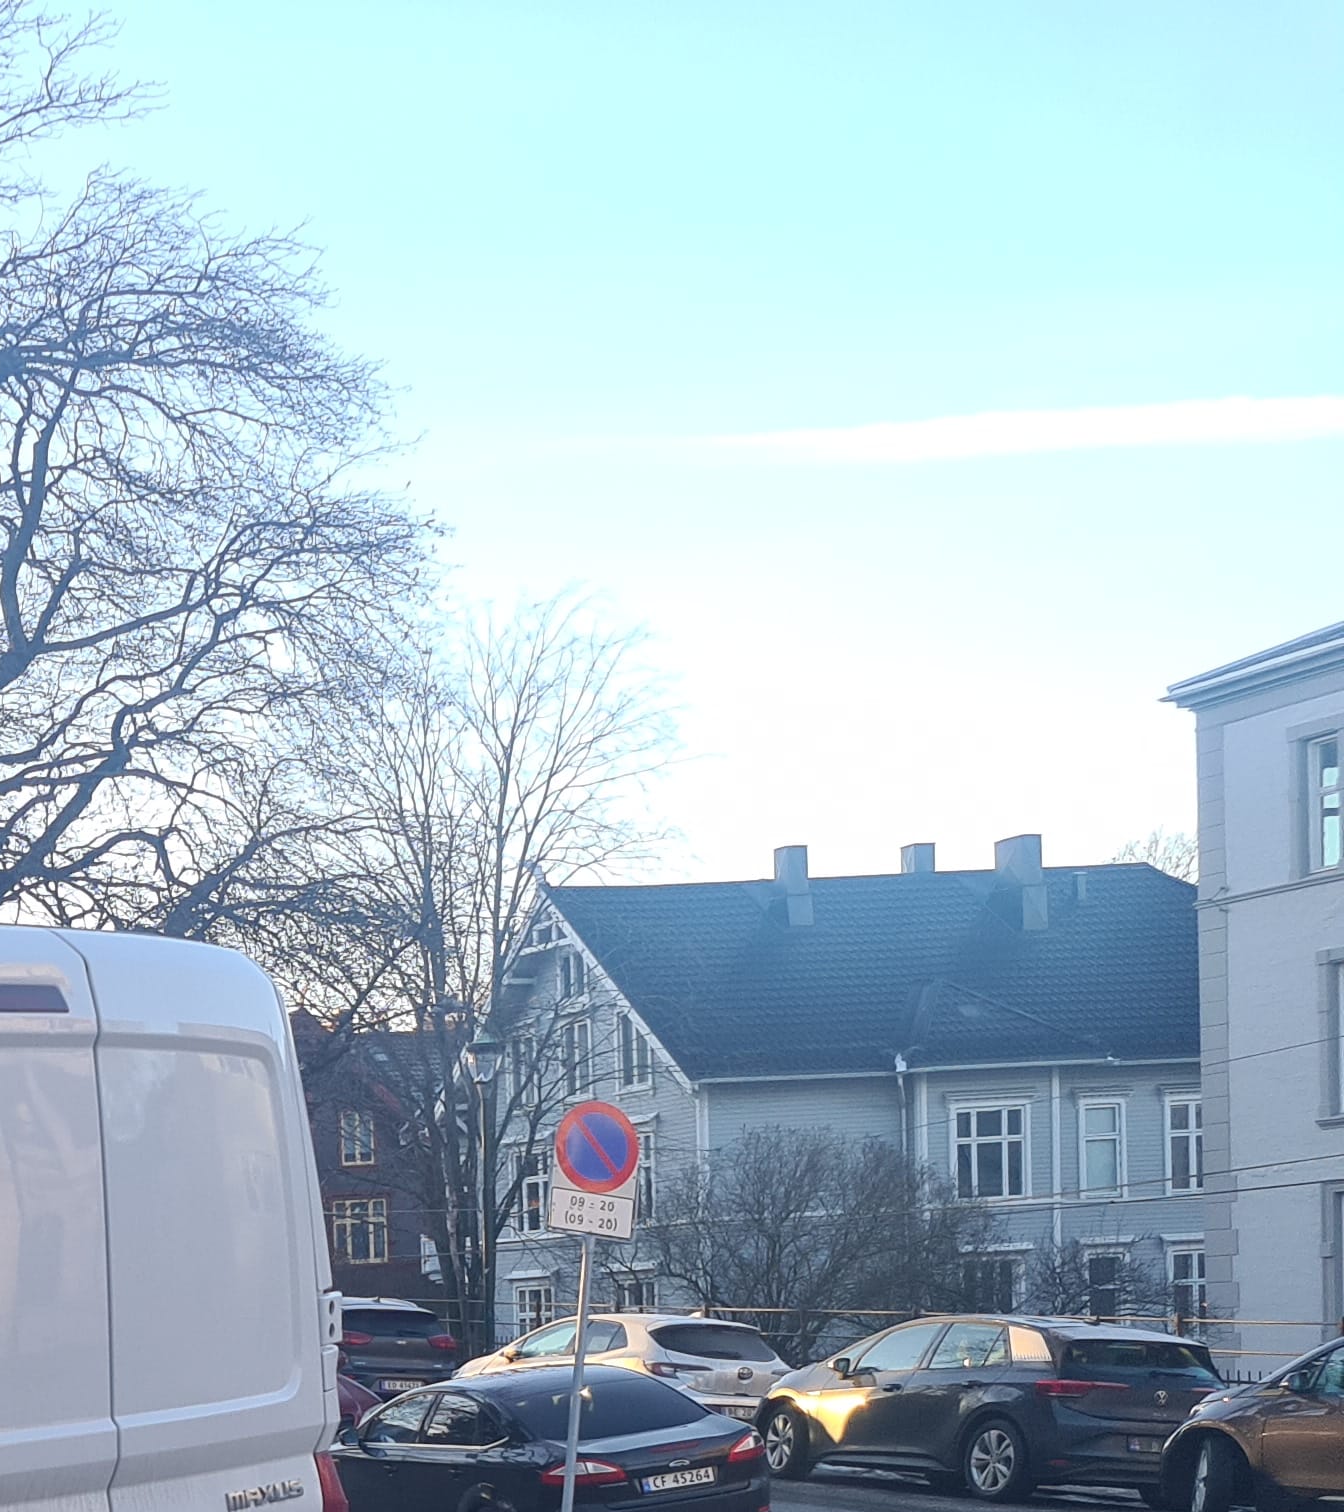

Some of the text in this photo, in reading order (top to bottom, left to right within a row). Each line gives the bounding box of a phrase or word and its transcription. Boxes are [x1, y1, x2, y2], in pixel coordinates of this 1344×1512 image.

[599, 1200, 615, 1212] 20
[565, 1210, 584, 1225] (09
[598, 1218, 618, 1232] 20)
[653, 1469, 710, 1488] CF 45264
[225, 1479, 304, 1512] MAXUS
